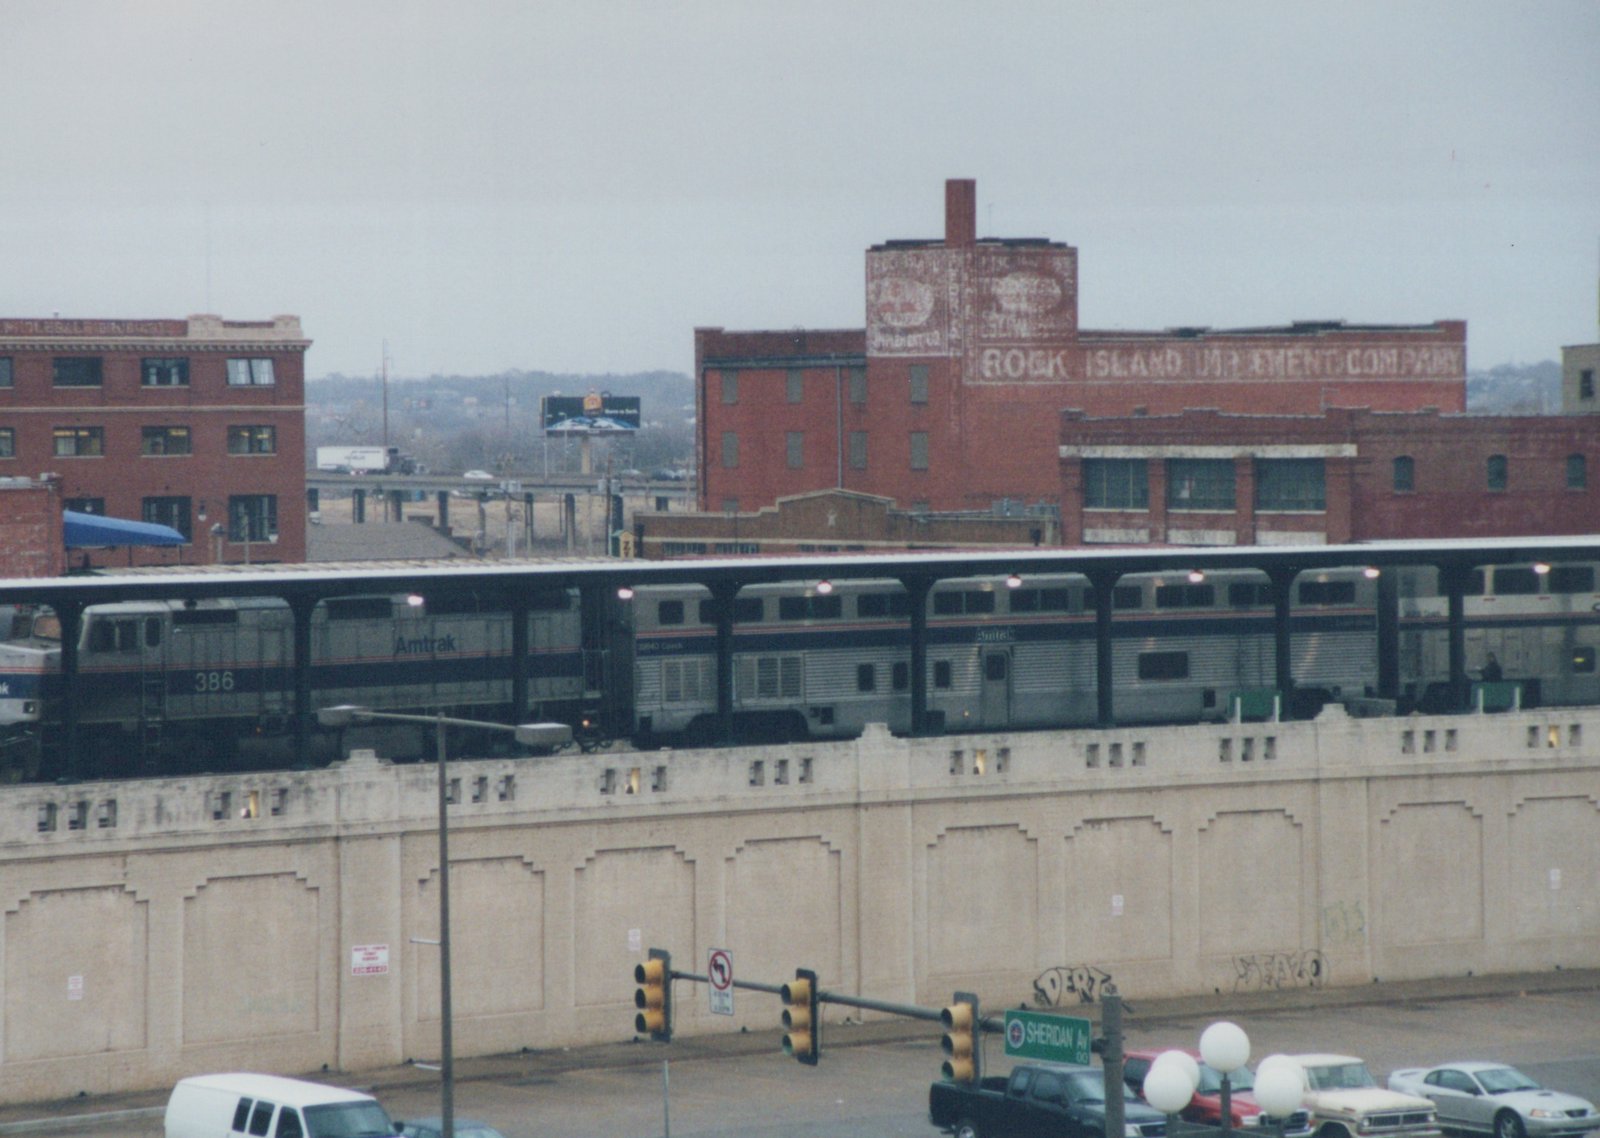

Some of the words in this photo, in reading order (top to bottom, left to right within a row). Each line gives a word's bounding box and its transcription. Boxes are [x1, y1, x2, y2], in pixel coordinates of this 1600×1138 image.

[980, 348, 1069, 378] ROCK
[1086, 349, 1182, 377] ISLAND
[394, 634, 457, 655] Amtrak
[194, 670, 236, 692] 386
[1026, 1020, 1074, 1049] SHERIDAN
